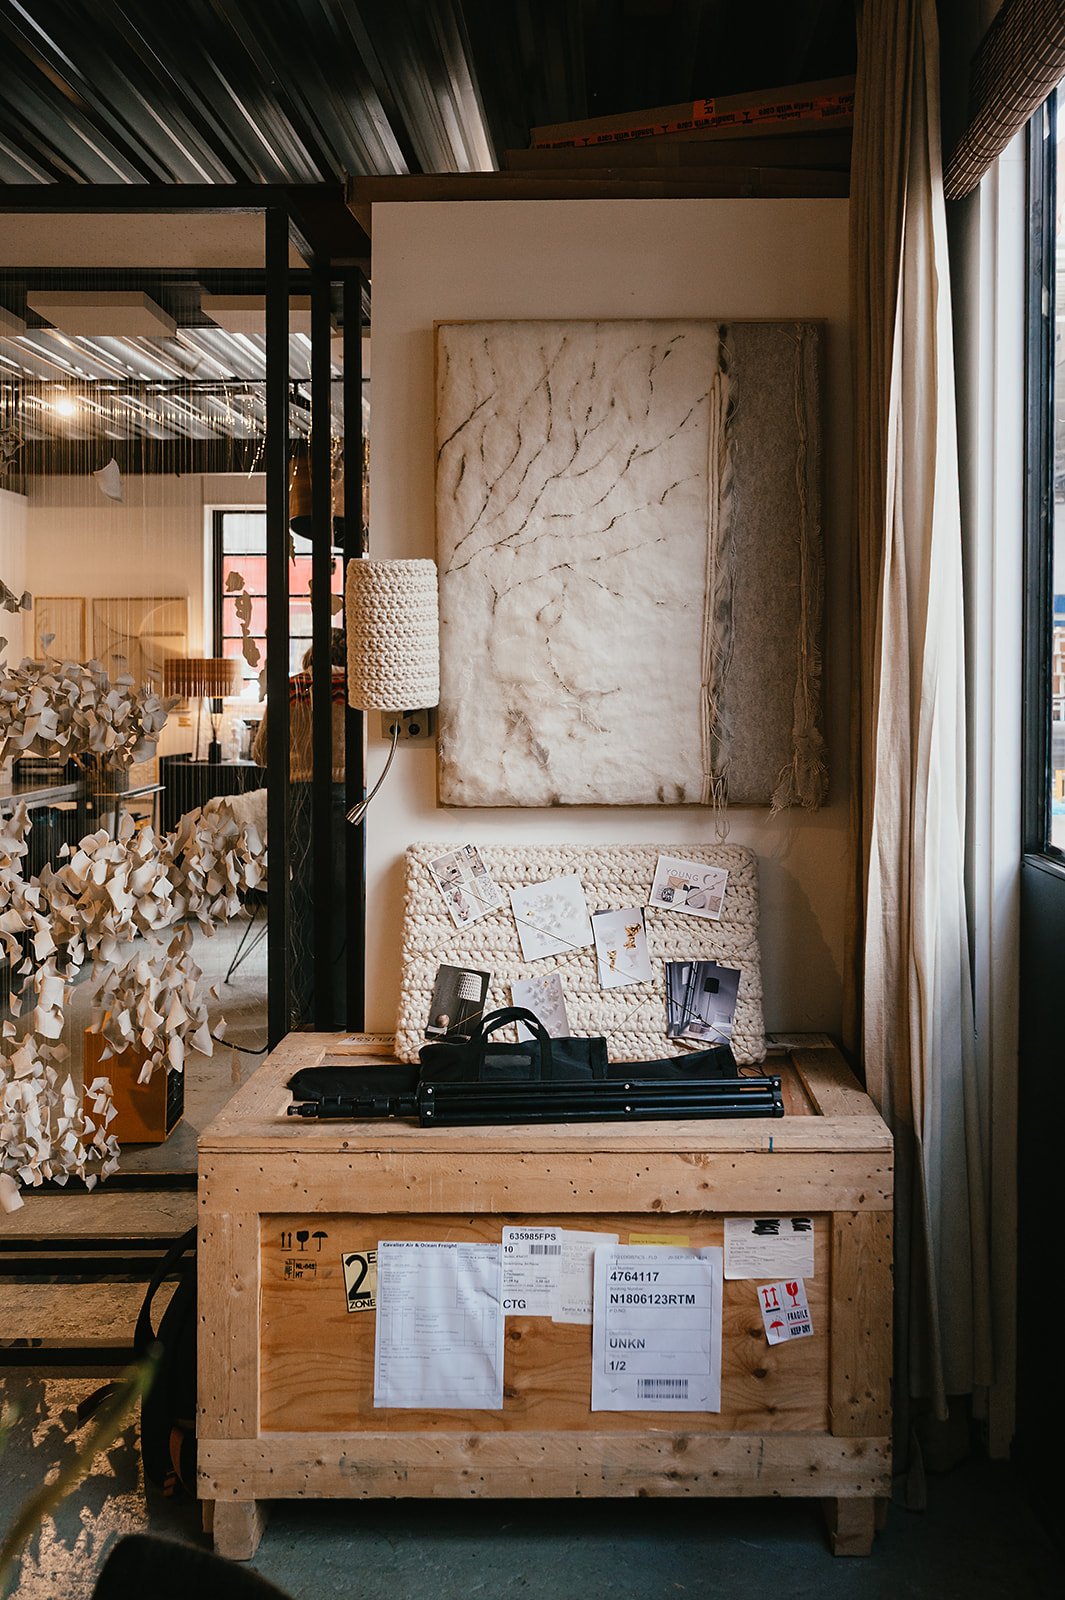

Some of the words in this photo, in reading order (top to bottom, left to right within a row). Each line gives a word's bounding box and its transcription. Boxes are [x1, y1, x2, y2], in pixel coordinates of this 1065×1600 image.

[666, 868, 699, 882] YOUNG
[509, 1232, 557, 1241] 635985FPS
[504, 1245, 514, 1254] 10
[610, 1271, 660, 1282] 4764117
[349, 1299, 376, 1310] ZONE
[503, 1299, 527, 1309] CTG
[610, 1293, 696, 1305] N1806123RTM
[787, 1309, 808, 1321] FRAGILE
[790, 1325, 801, 1336] KEEP
[801, 1324, 811, 1334] DRY
[609, 1338, 646, 1349] UNKN
[609, 1360, 626, 1371] 1/2
